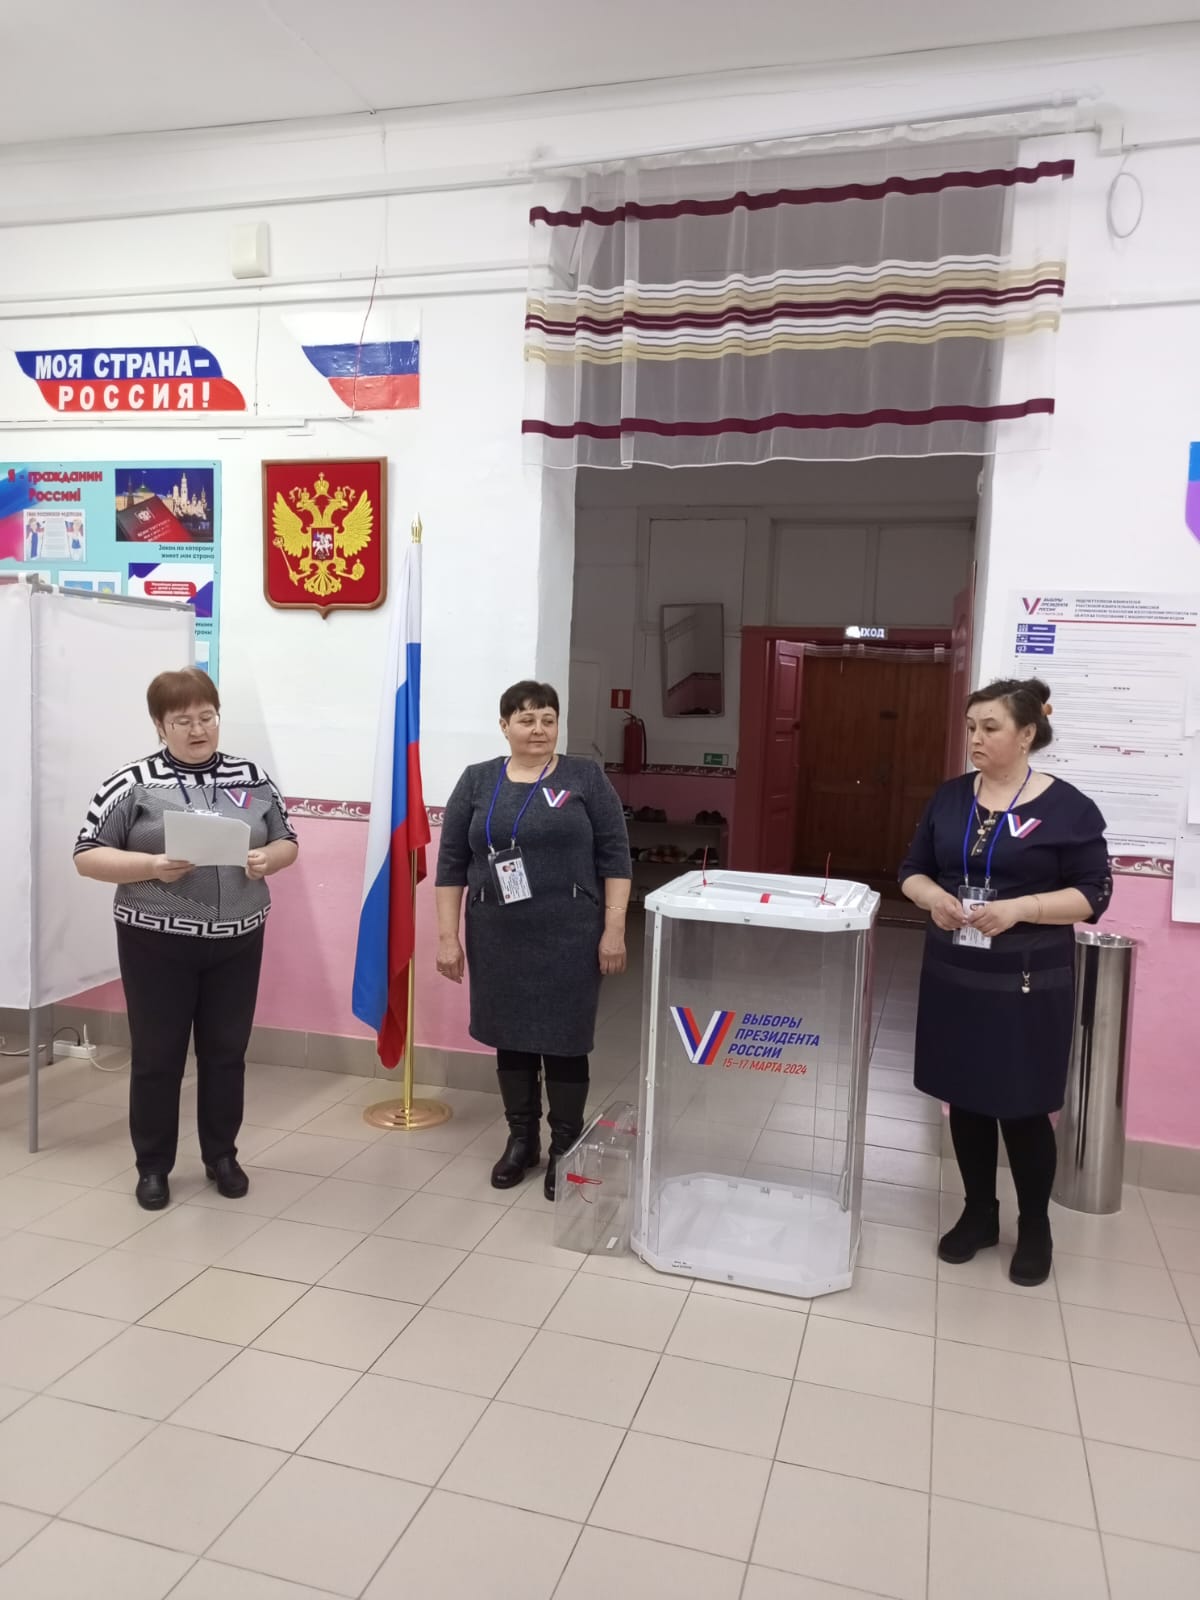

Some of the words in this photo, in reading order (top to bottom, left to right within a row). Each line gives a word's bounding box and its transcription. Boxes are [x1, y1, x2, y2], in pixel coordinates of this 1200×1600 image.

[35, 353, 83, 380] МОЯ
[58, 381, 210, 411] РОССИЯ!
[28, 471, 103, 485] гражданин
[742, 1013, 803, 1029] ВЫБОРЫ
[735, 1028, 820, 1047] ПРЕЗИДЕНТА
[728, 1043, 783, 1059] РОССИИ
[750, 1060, 781, 1073] МАРТА
[784, 1063, 808, 1075] 2024
